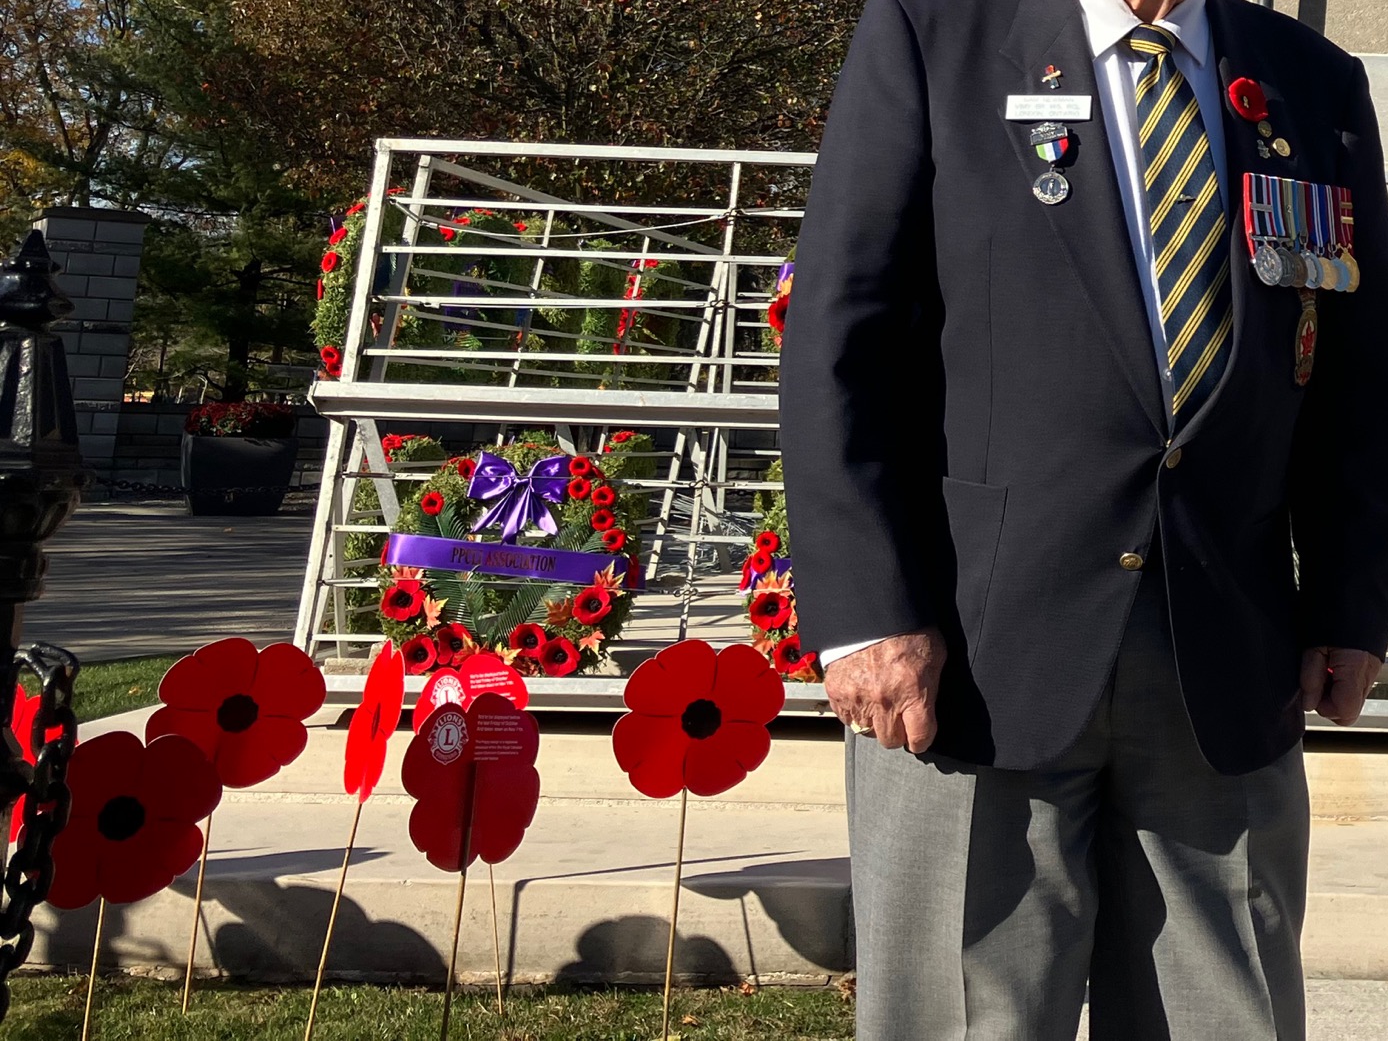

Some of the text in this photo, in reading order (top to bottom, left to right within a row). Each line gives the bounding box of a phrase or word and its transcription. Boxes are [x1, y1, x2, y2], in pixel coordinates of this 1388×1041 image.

[485, 548, 557, 572] ASSOCIATION
[437, 677, 458, 689] LIONS
[438, 714, 463, 726] LIONS
[443, 728, 454, 746] L
